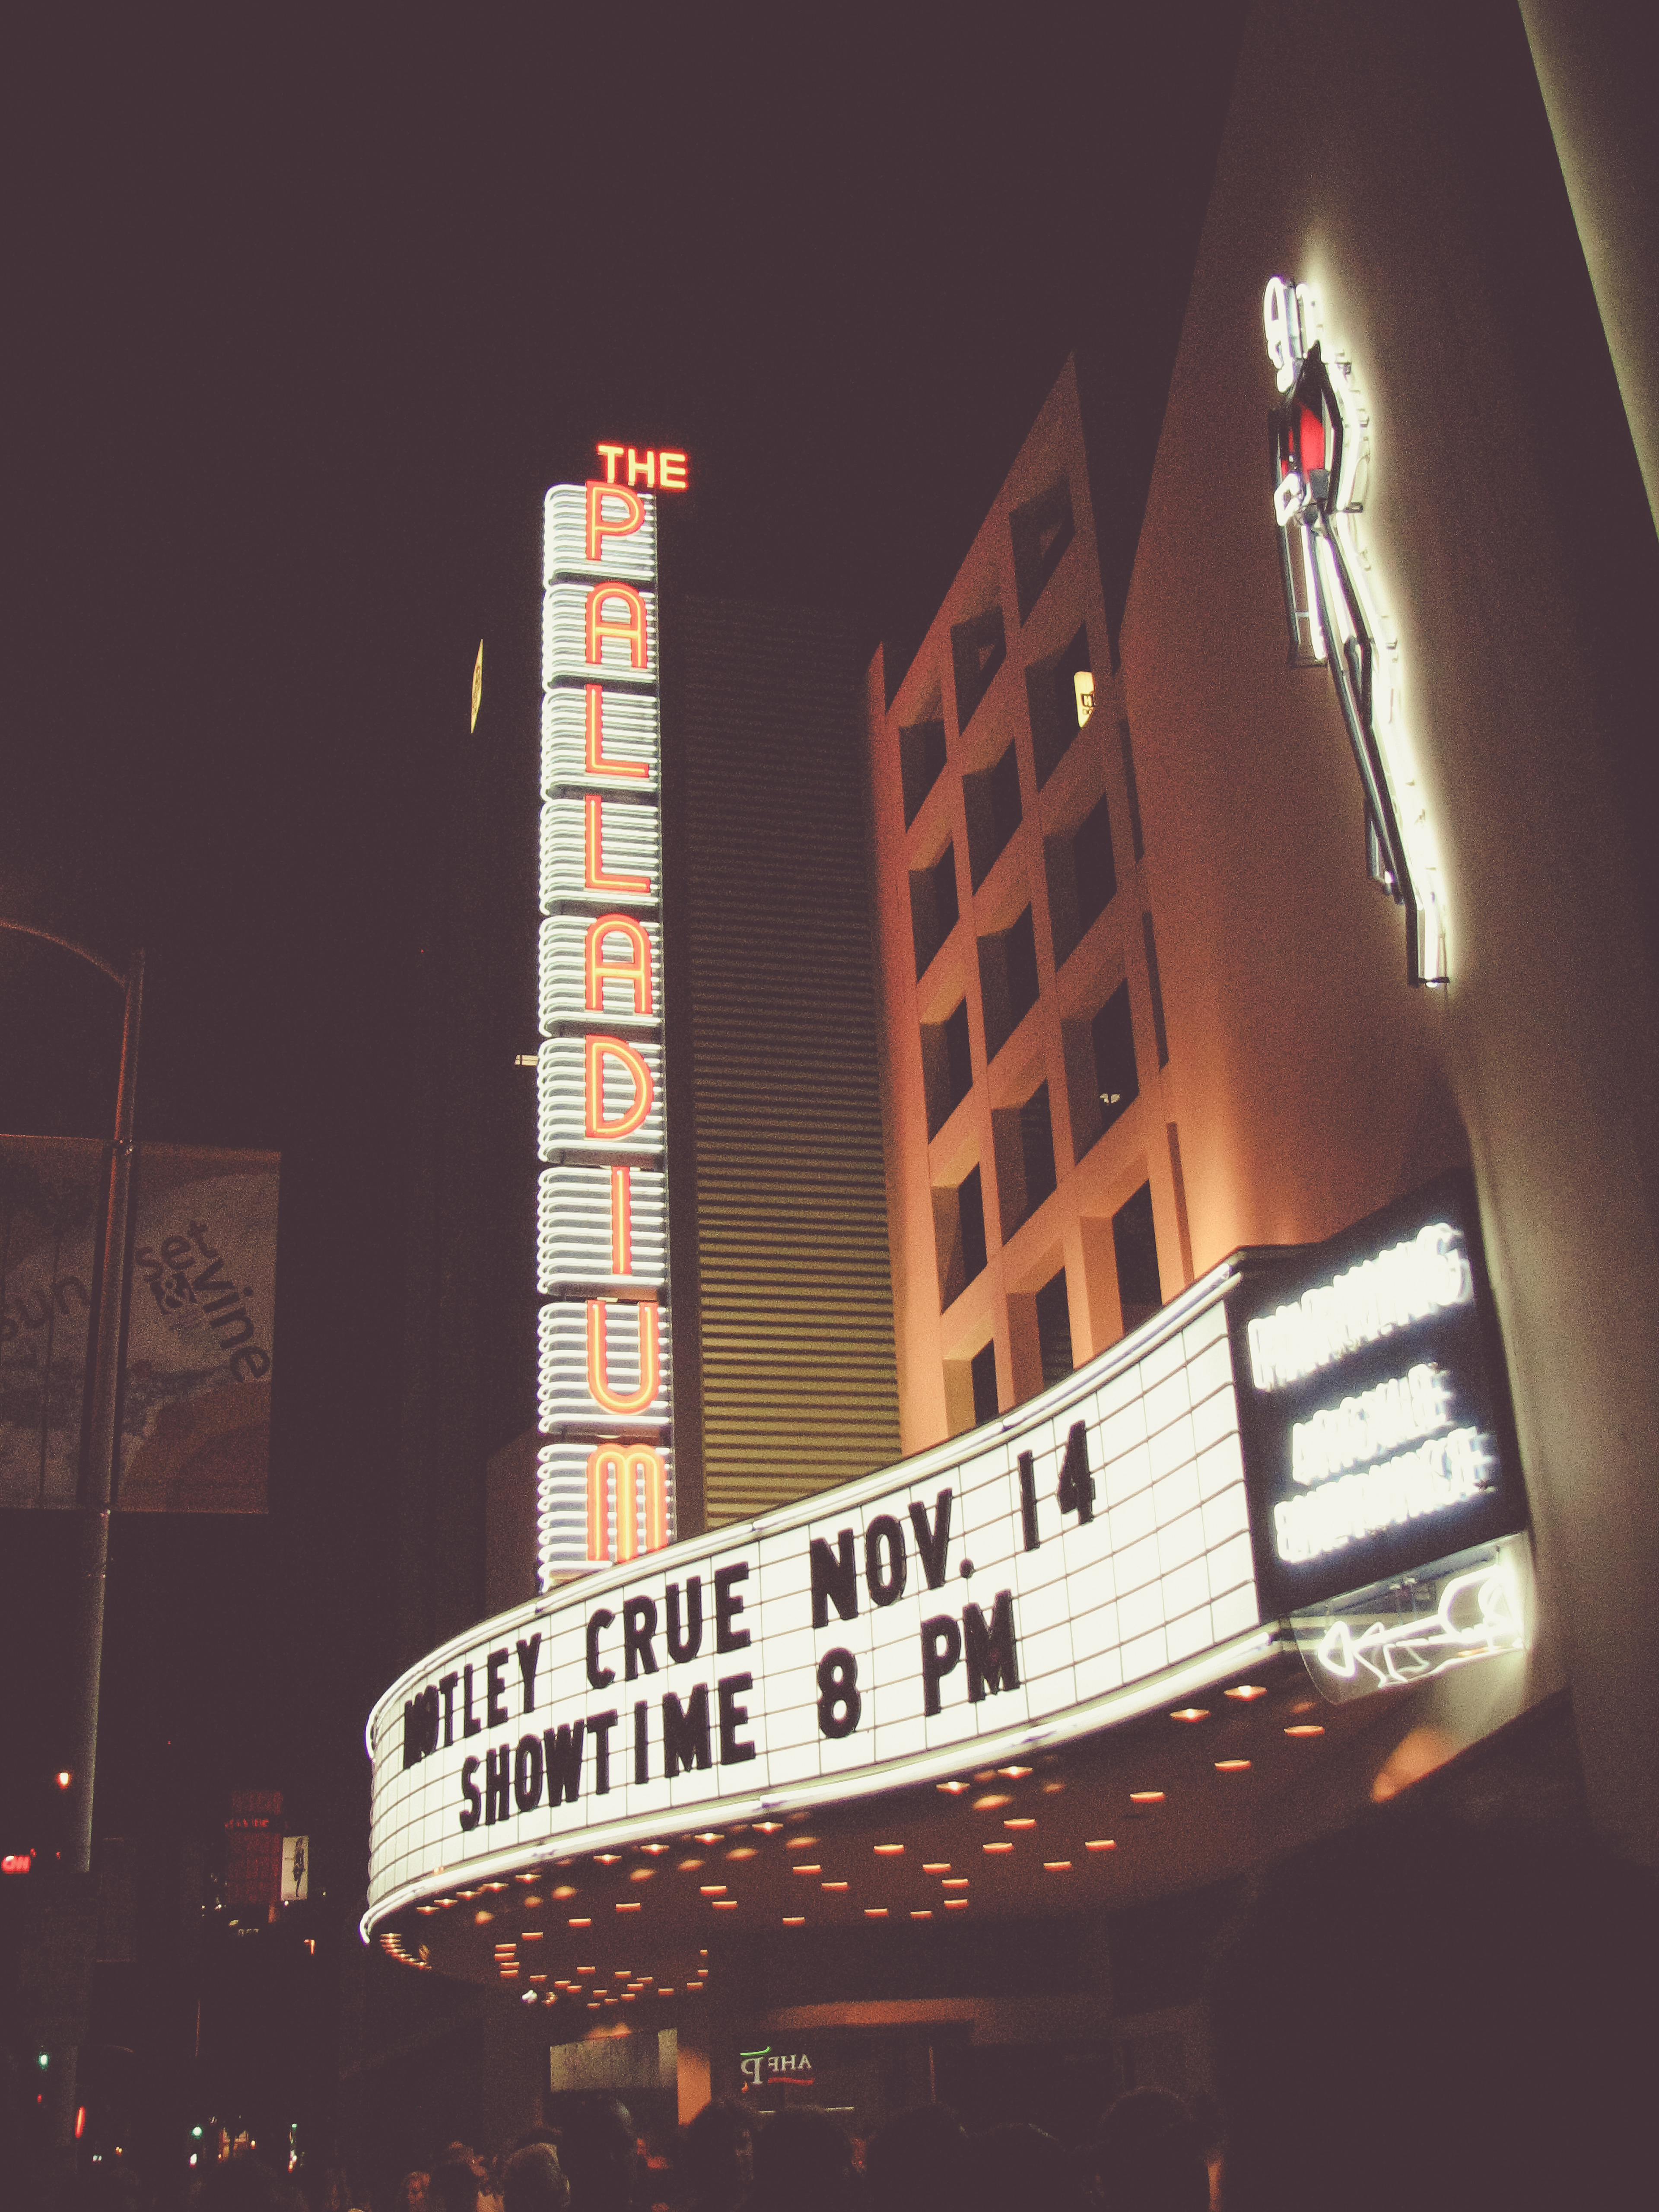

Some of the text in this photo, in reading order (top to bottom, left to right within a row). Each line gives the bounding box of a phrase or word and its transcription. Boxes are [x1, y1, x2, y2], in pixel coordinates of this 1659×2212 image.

[598, 445, 688, 489] THE
[585, 480, 668, 1563] PALLADIUM
[136, 1219, 219, 1283] set
[192, 1257, 270, 1382] vine
[402, 1420, 1096, 1770] MOTLEY CRUE NOV. 14
[459, 1589, 1021, 1831] SHOWTIME 8 PM
